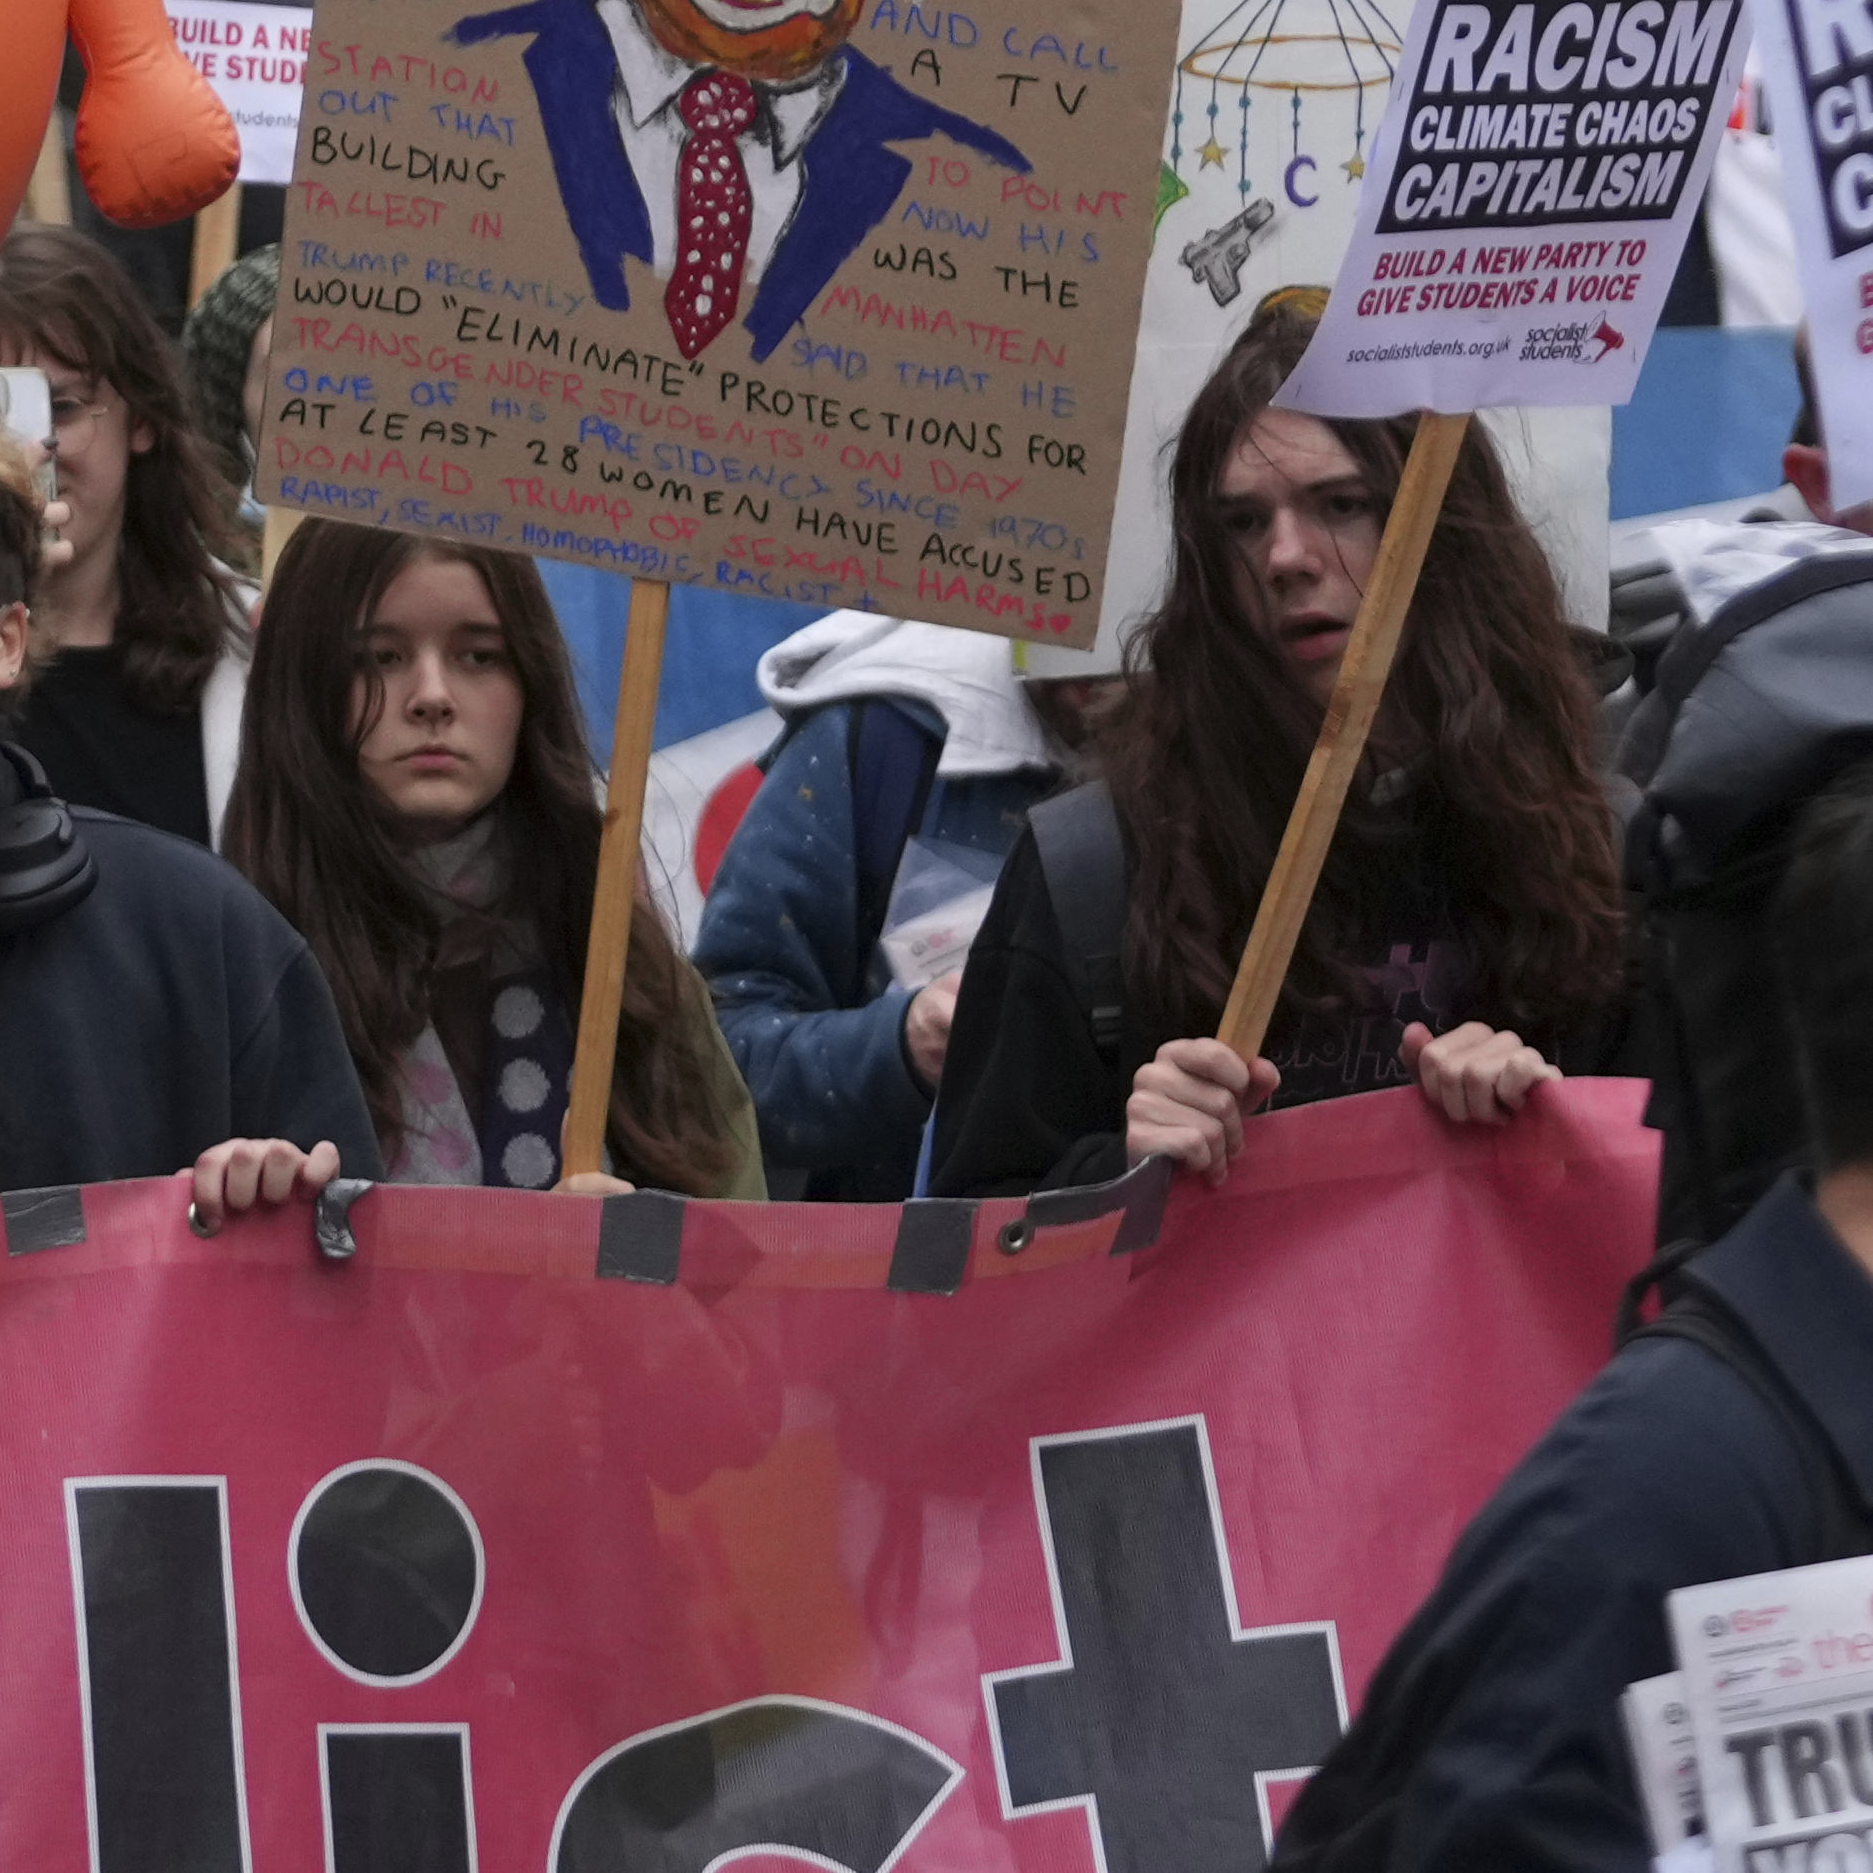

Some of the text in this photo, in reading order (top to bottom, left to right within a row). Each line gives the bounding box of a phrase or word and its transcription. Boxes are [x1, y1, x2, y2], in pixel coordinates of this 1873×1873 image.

[911, 48, 942, 86] A
[1003, 27, 1118, 72] CALL
[1424, 0, 1733, 92] RACISM
[312, 127, 1079, 308] BUILDING WAS THE
[1395, 151, 1684, 220] CAPITALISM
[294, 277, 421, 315] WOULD
[720, 372, 1003, 459] PROTECTIONS
[1027, 435, 1086, 475] FOR
[1346, 336, 1511, 363] socialiststudents.org.uk
[280, 399, 1091, 603] AT LEAST 28 WOMEN HAVE ACCUSED
